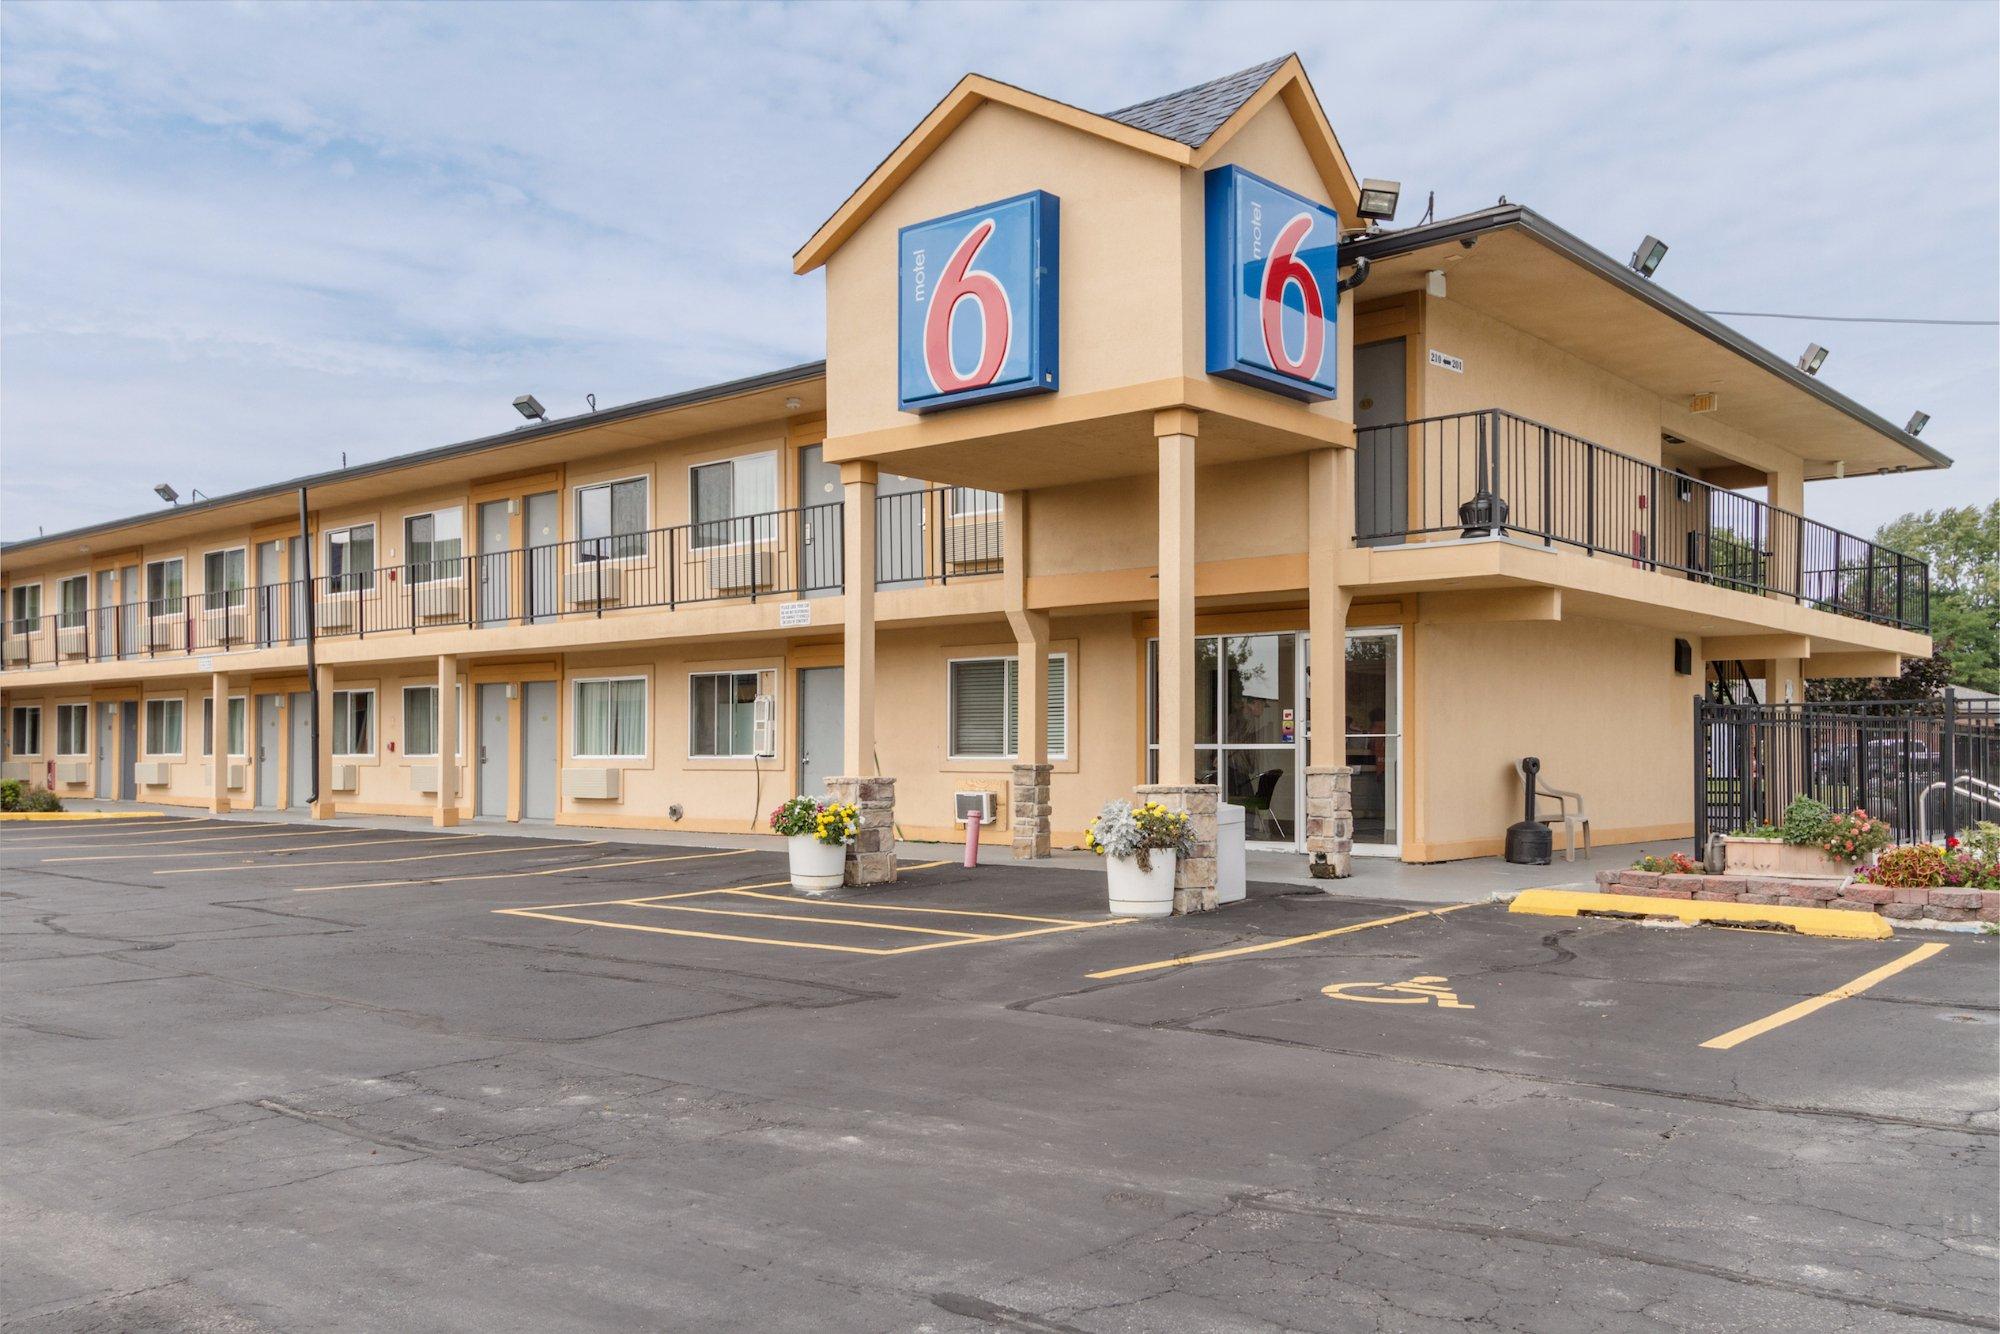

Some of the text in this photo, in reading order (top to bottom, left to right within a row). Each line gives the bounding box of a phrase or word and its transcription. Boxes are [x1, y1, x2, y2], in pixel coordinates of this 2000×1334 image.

[913, 249, 925, 301] motel
[1252, 201, 1262, 260] motel
[923, 218, 1012, 393] 6
[1260, 212, 1325, 381] 6
